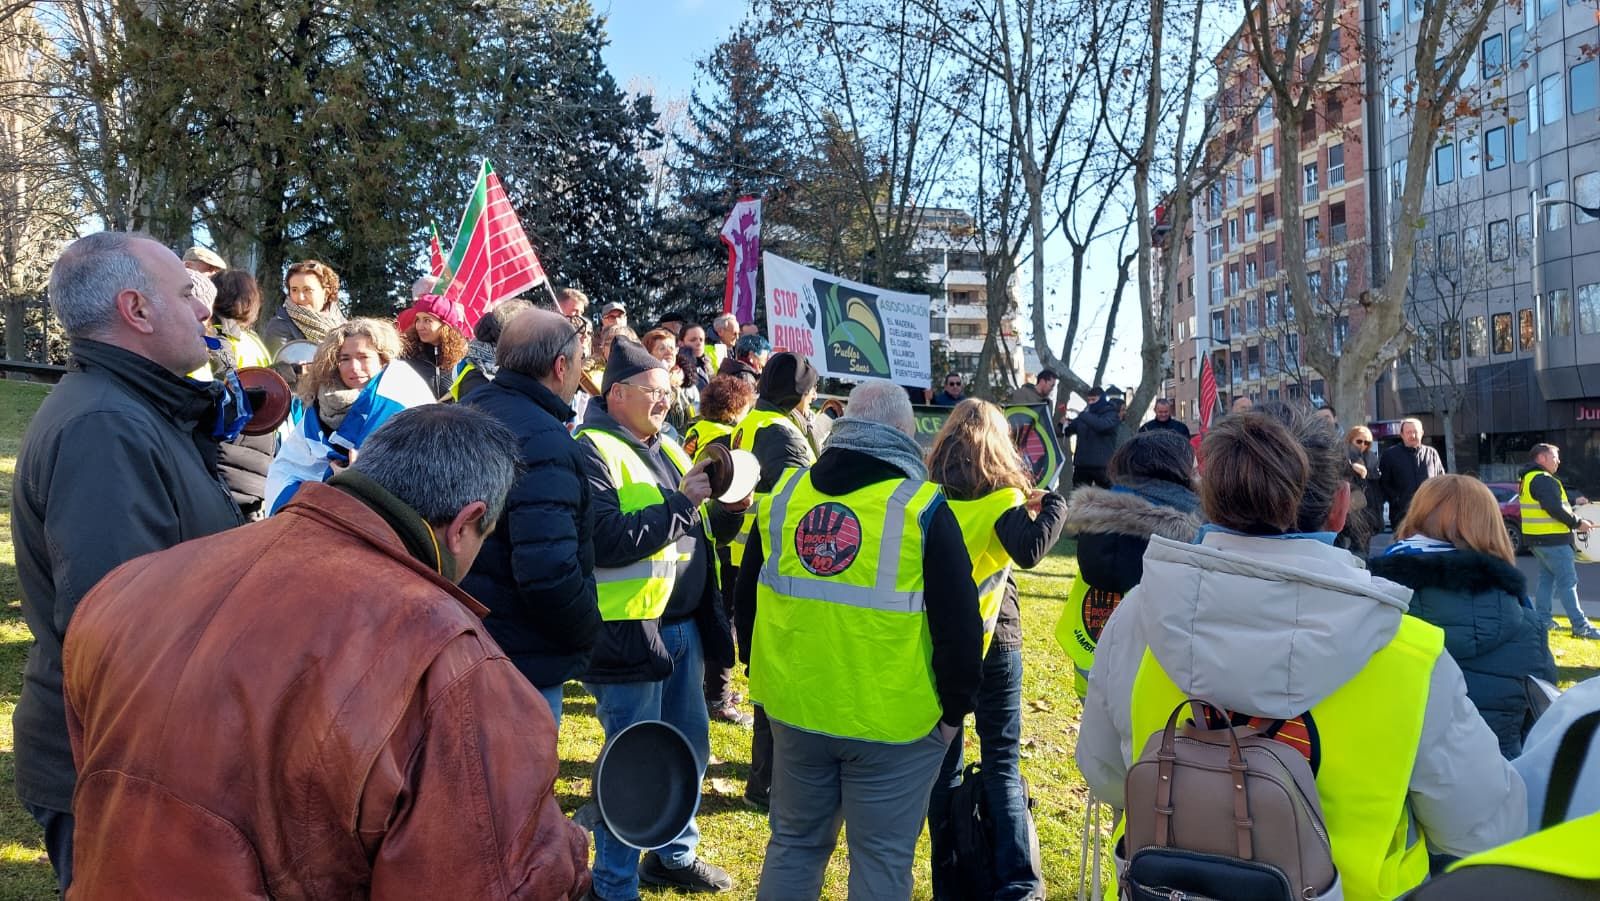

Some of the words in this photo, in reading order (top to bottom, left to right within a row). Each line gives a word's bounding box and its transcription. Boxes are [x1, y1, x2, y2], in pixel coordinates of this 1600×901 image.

[774, 288, 798, 317] STOP
[775, 325, 814, 356] BIOGÁS
[833, 343, 860, 359] Pueblos
[849, 359, 870, 374] Sanos
[1074, 629, 1096, 654] JAMBR
